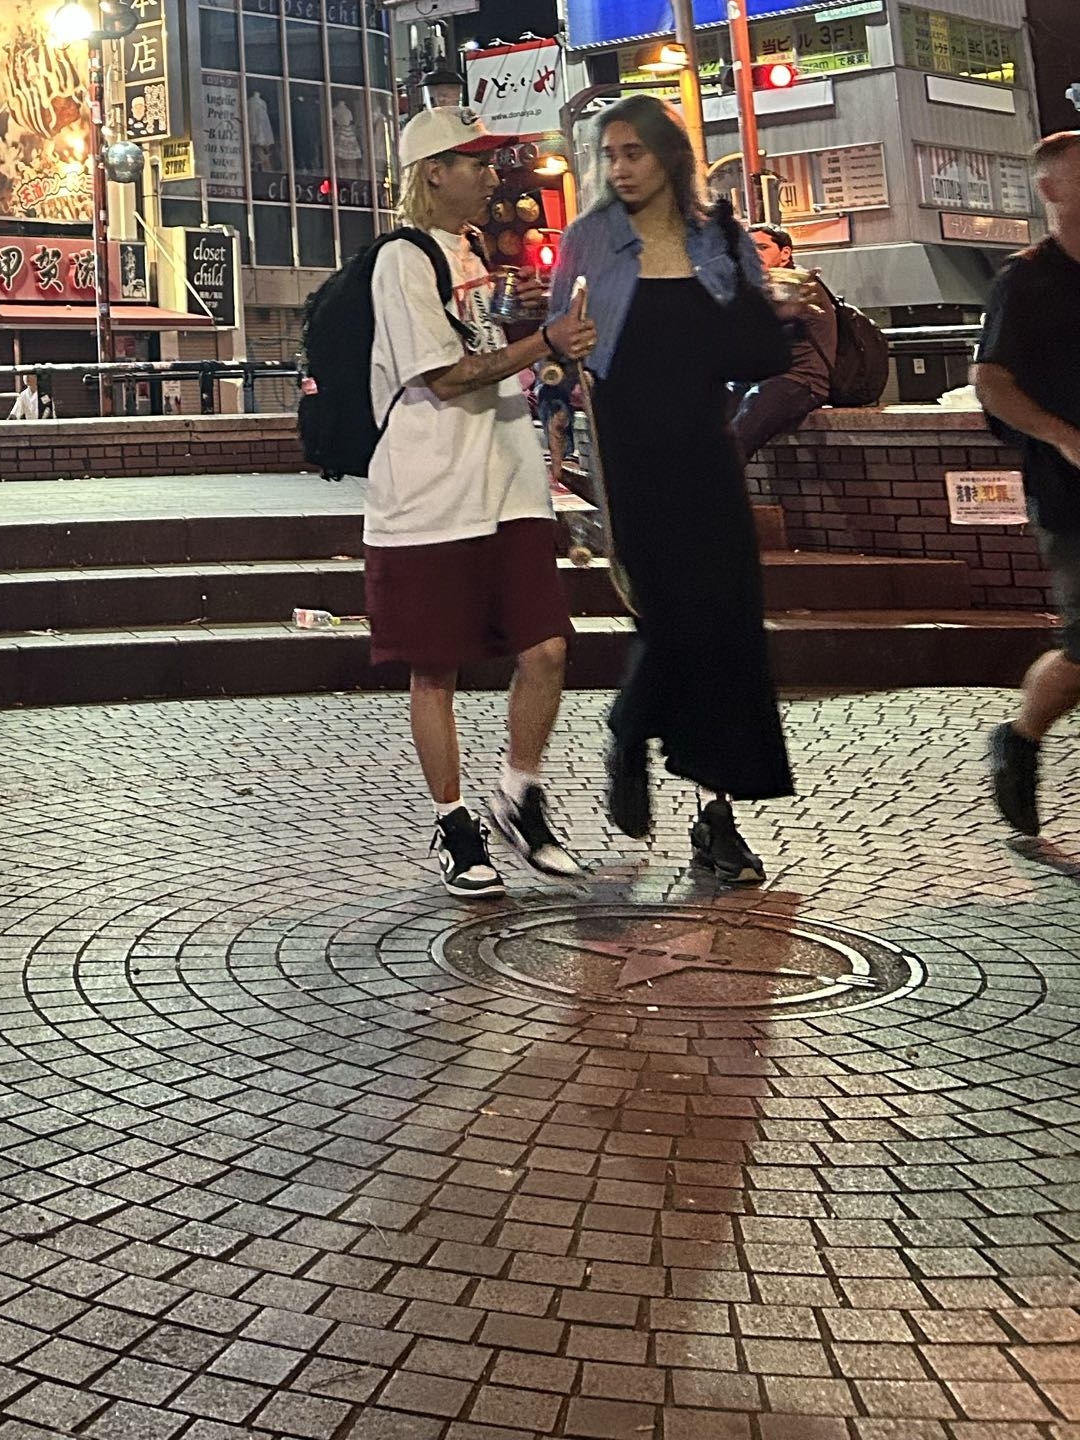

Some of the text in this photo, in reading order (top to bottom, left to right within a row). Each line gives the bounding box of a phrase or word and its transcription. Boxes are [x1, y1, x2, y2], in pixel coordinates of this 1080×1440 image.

[165, 159, 188, 175] STORE
[193, 237, 227, 261] closet
[193, 262, 227, 286] child
